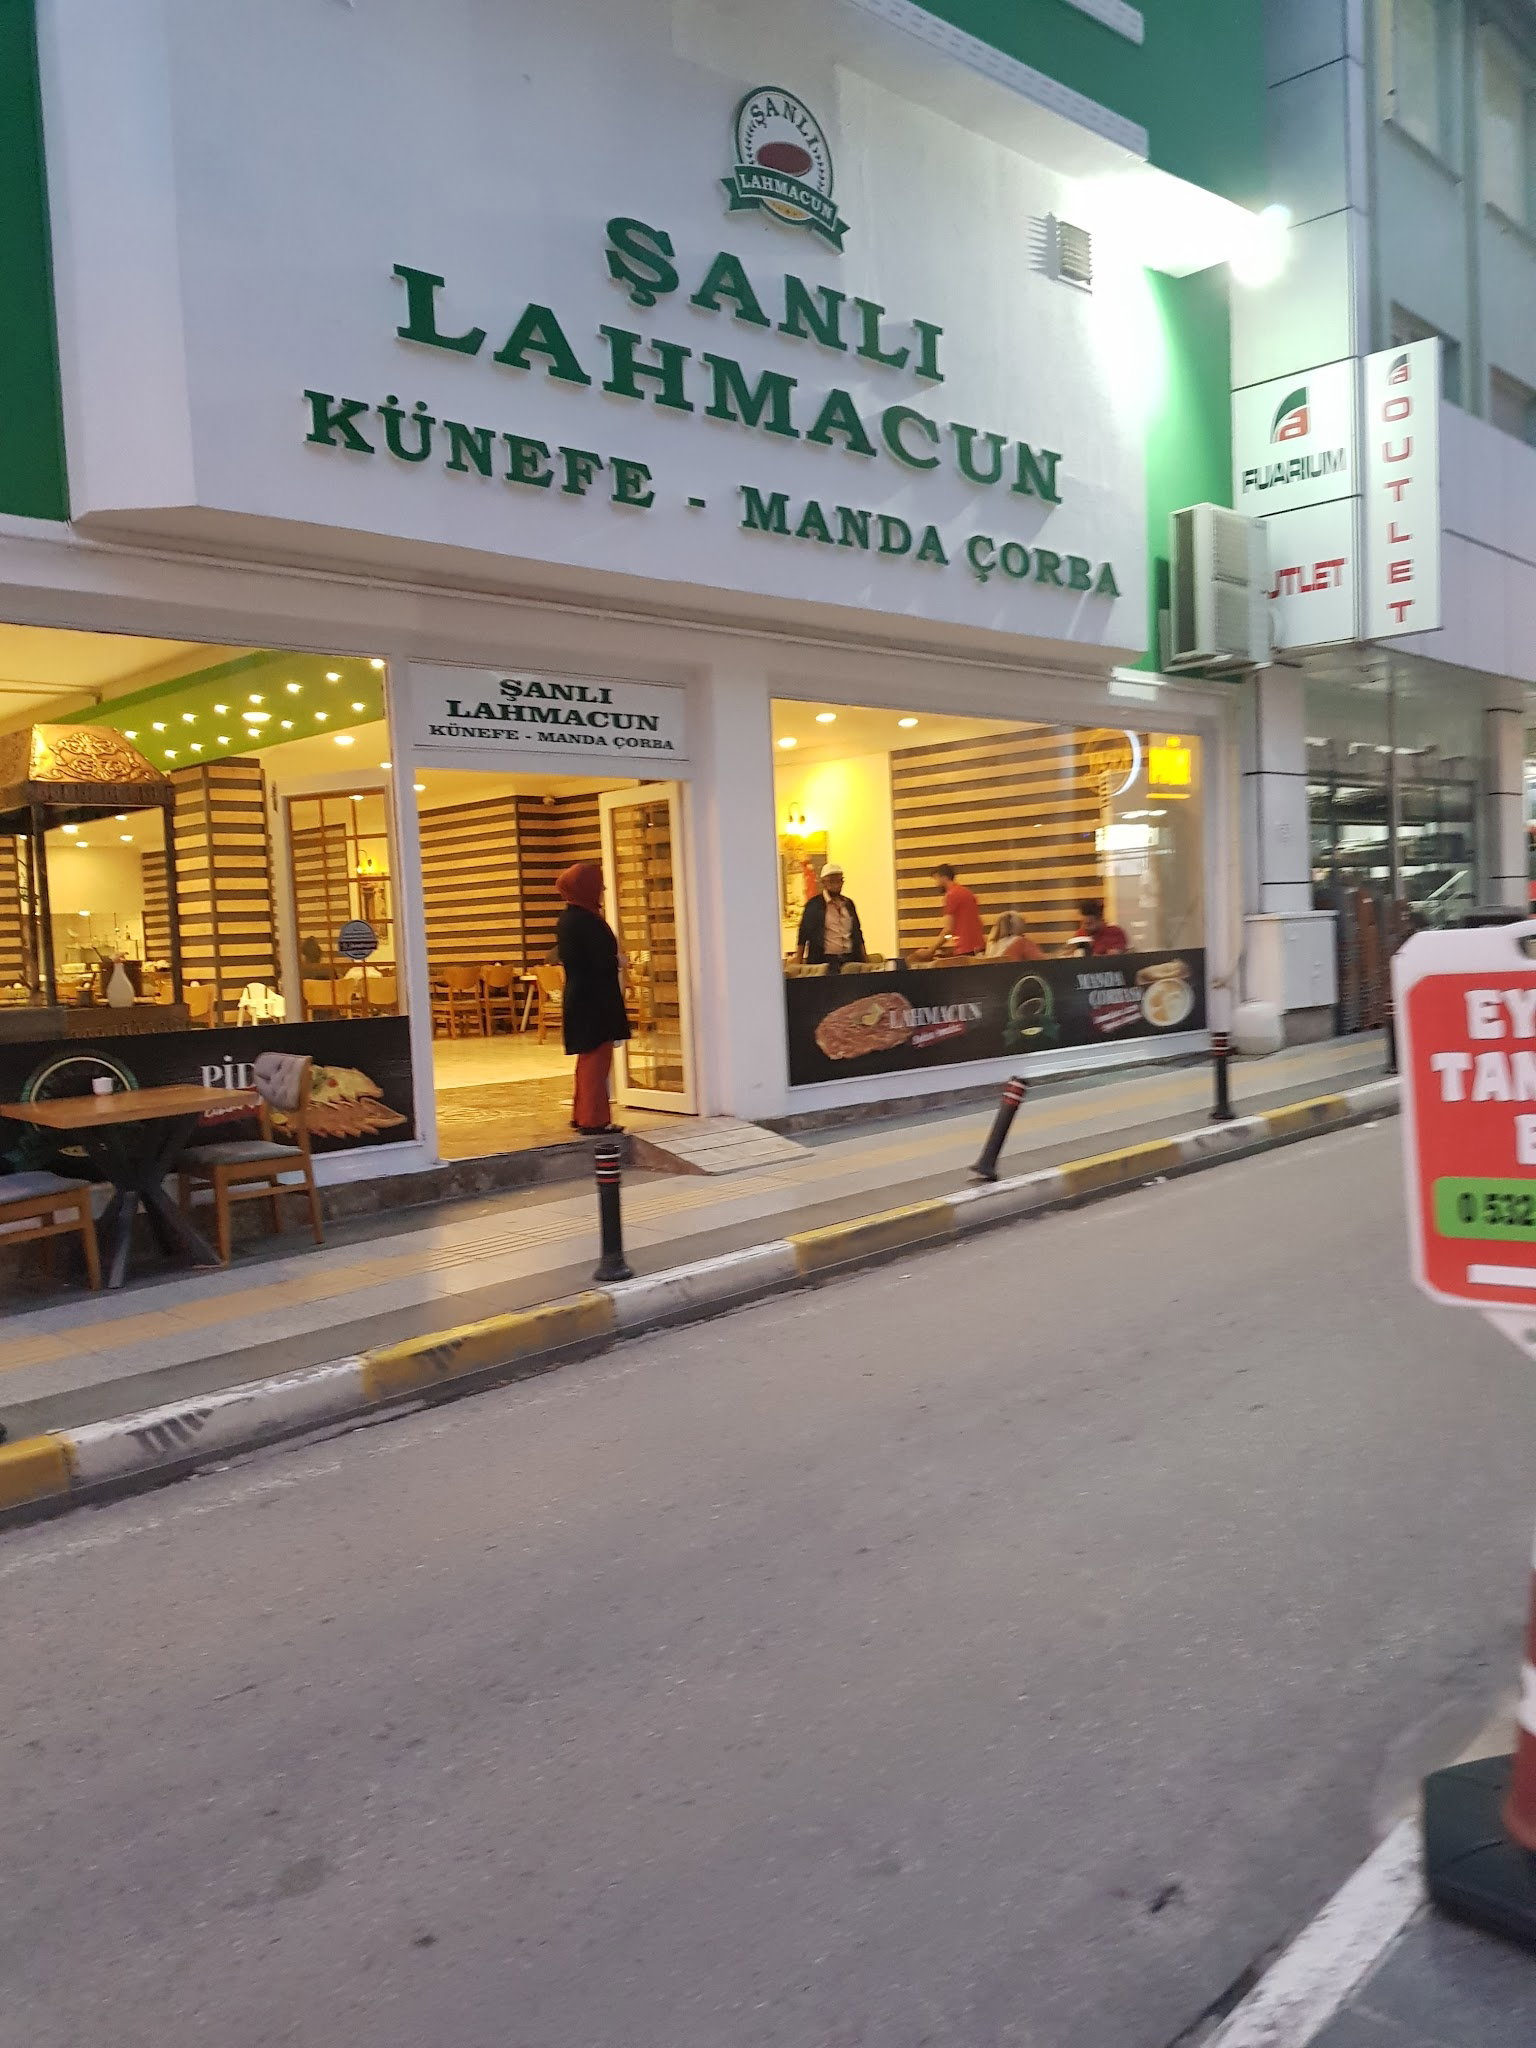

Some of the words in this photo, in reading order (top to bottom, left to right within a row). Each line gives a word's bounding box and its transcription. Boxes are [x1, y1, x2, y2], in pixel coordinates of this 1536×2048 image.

[739, 174, 834, 219] LAHMACUN
[605, 217, 945, 382] ŞANLI
[392, 263, 1062, 503] LAHMACUN
[303, 390, 655, 508] KÜNEFE
[740, 485, 950, 565] MANDA
[966, 535, 1121, 597] ÇORBA
[1242, 448, 1346, 494] FUARIUM
[1383, 397, 1415, 623] OUTLET
[500, 679, 613, 704] ŞANLI
[429, 723, 519, 740] KÜNEFE
[537, 732, 607, 746] MANDA
[613, 737, 674, 749] ÇORBA
[446, 700, 659, 731] LAHMACUN
